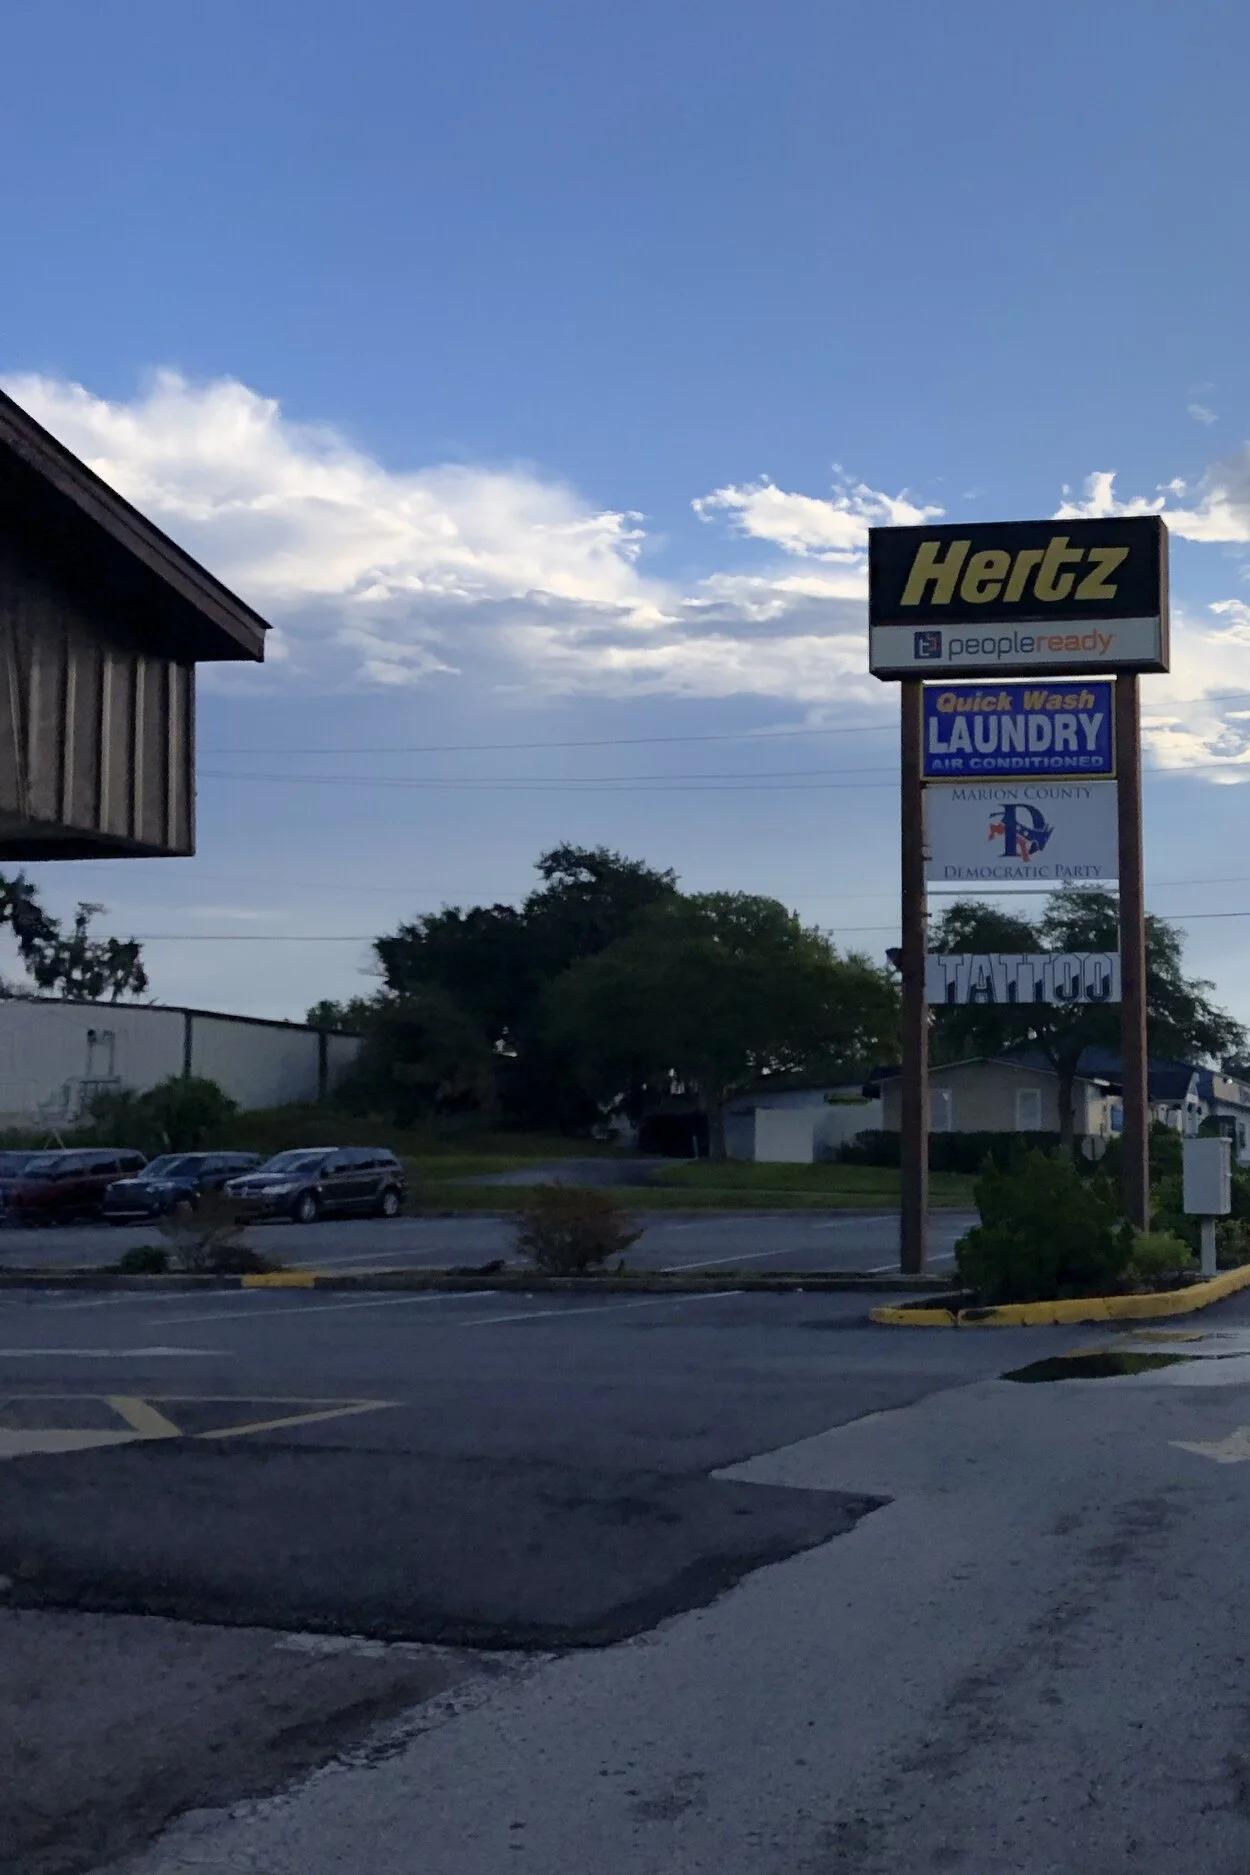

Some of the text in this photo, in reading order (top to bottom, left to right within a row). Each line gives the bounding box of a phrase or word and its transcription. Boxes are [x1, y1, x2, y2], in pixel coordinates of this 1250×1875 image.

[900, 536, 1130, 606] Hertz
[949, 628, 1114, 661] peopleready
[935, 689, 1096, 713] Quick Wash
[928, 711, 1105, 755] LAUNDRY
[931, 756, 1104, 770] AIR CONDITIONED
[951, 786, 1095, 801] MARION COUNTY
[944, 863, 1103, 880] DEMOCRATIC PARTY
[937, 953, 1113, 1002] TATTOO
